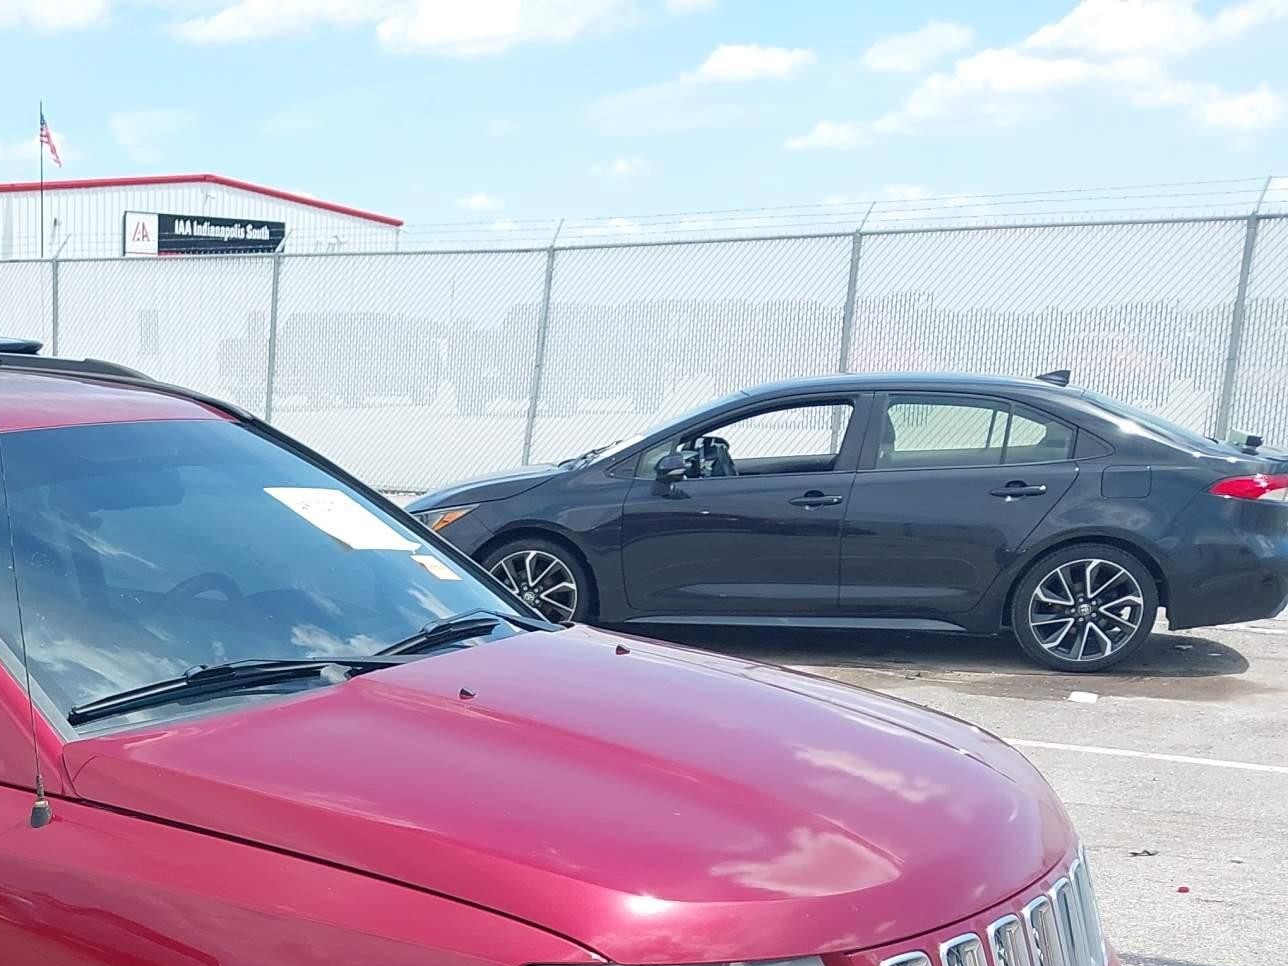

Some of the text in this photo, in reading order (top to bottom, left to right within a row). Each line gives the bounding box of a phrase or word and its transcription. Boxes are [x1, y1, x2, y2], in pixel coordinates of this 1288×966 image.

[174, 219, 269, 241] IAA Indianapolis South
